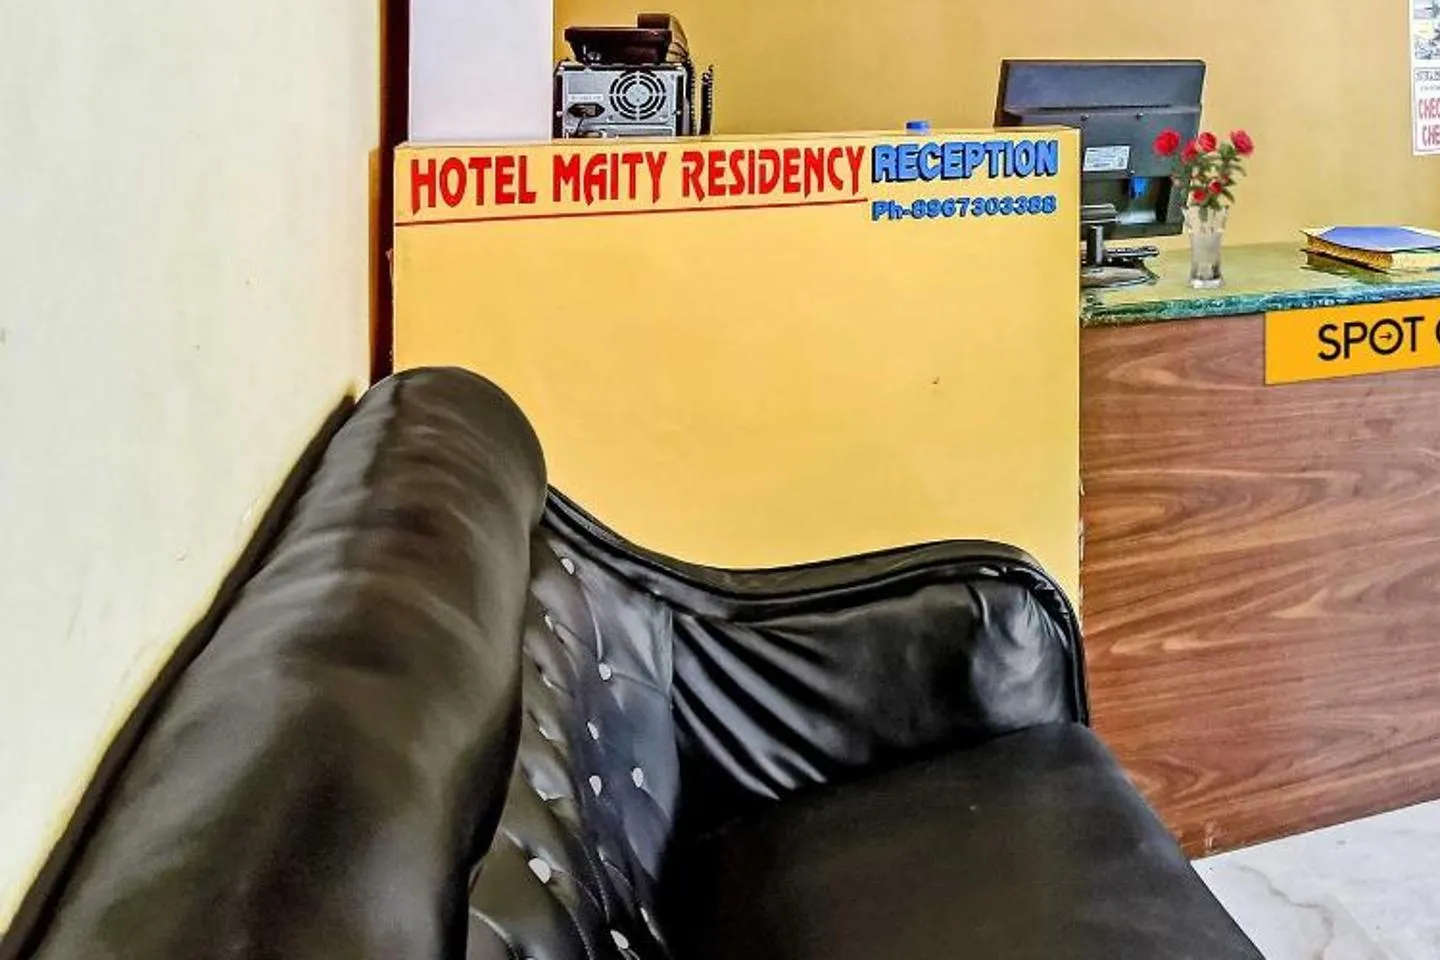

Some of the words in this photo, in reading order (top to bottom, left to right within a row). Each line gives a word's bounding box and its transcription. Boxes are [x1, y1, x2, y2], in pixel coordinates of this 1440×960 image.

[410, 155, 537, 216] HOTEL
[552, 151, 668, 206] MAITY
[681, 145, 866, 203] RESIDENCY
[871, 140, 1059, 183] RECEPTION
[1317, 315, 1426, 361] SPOT
